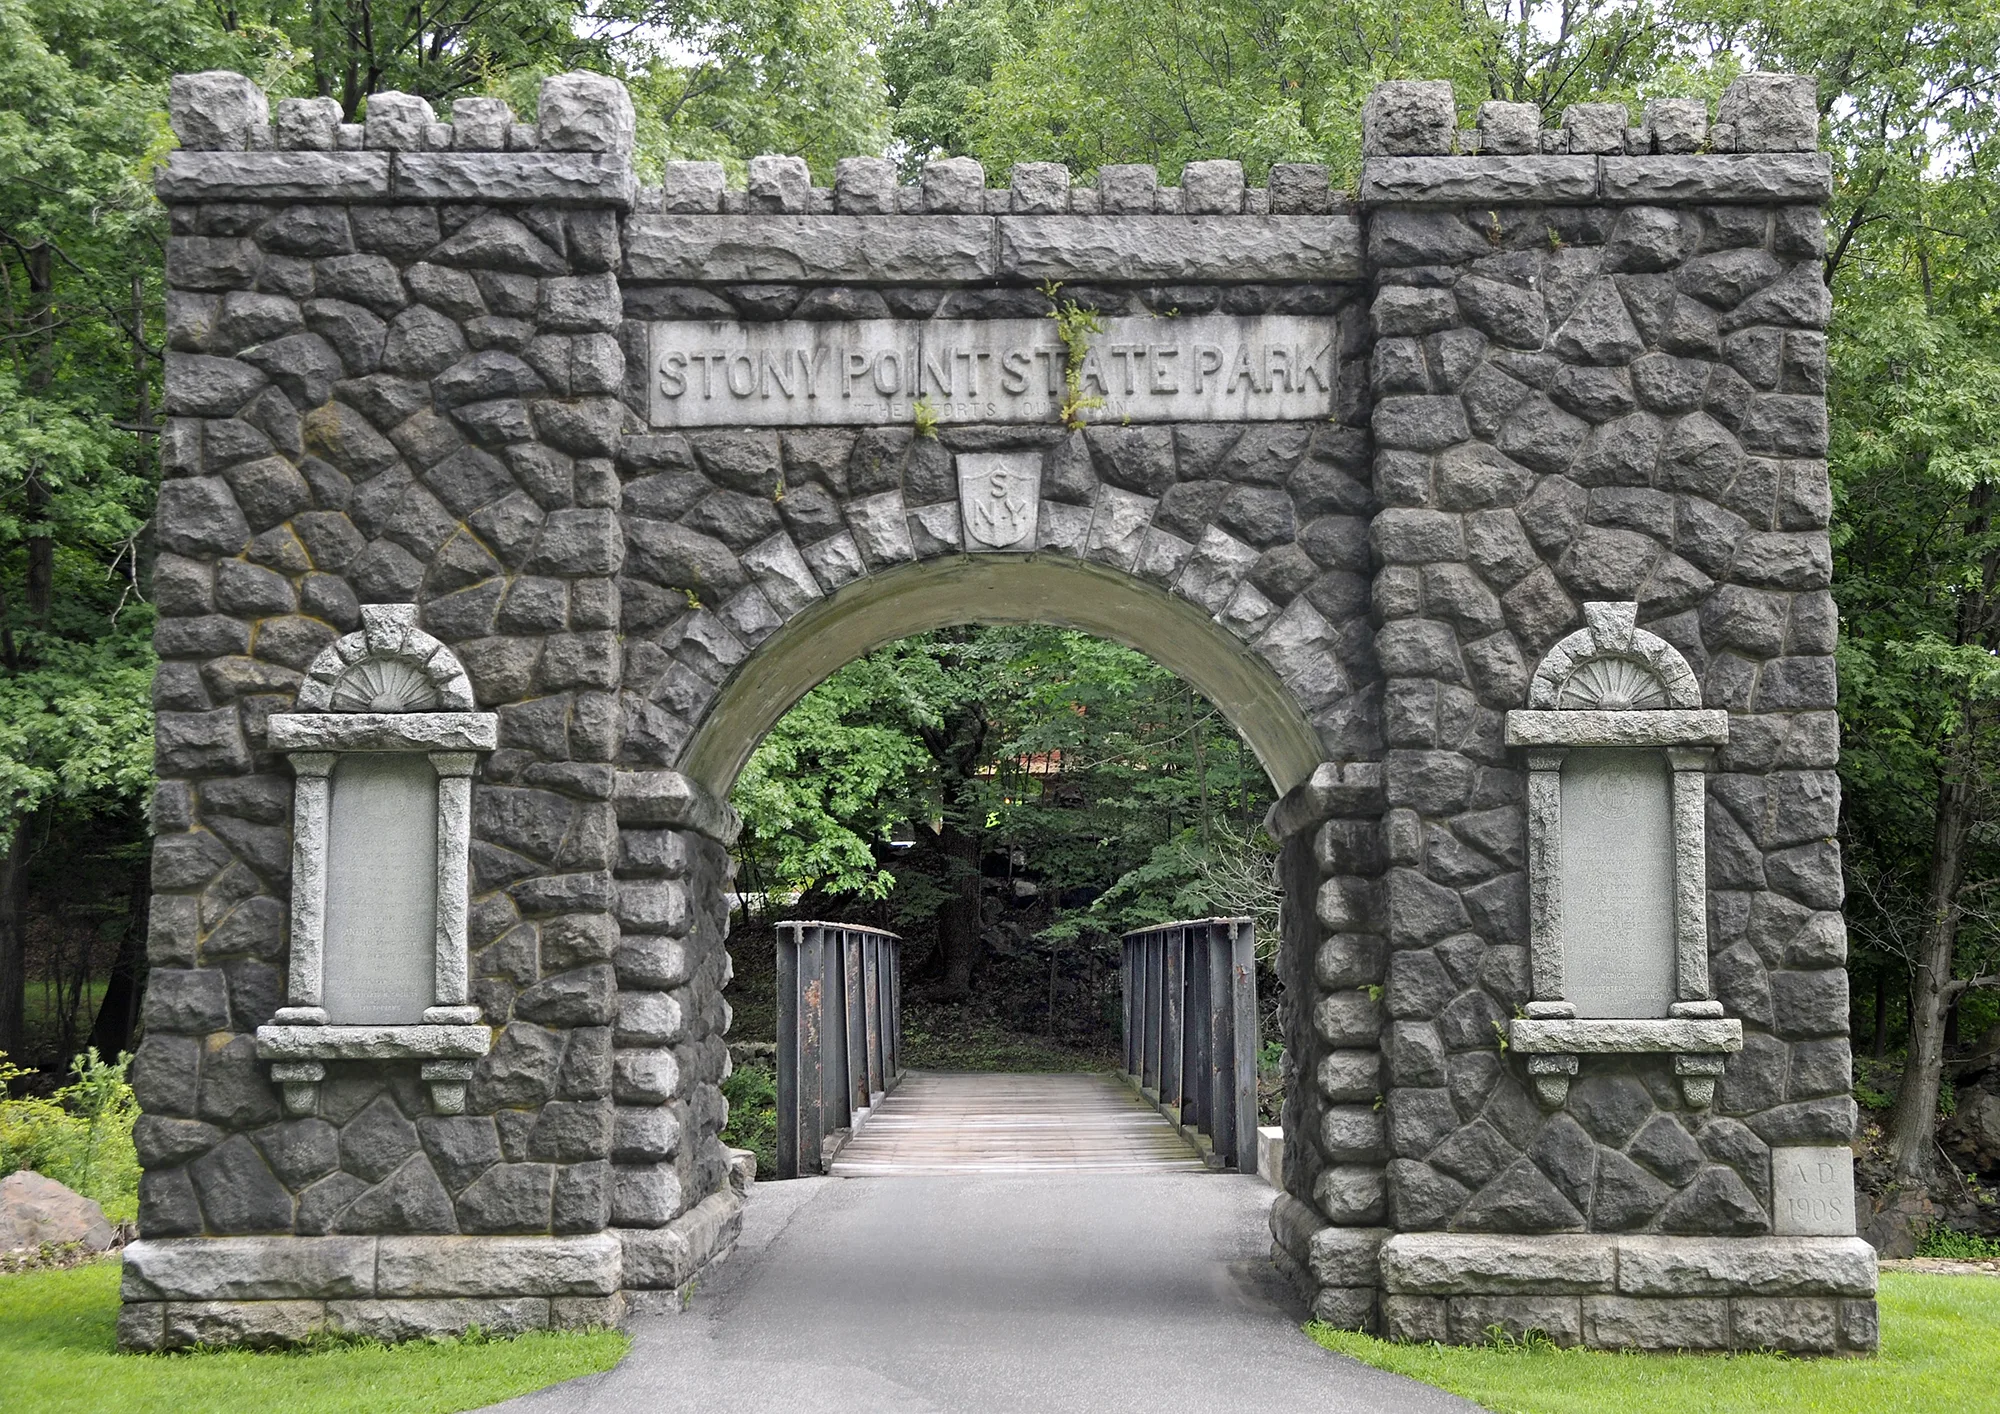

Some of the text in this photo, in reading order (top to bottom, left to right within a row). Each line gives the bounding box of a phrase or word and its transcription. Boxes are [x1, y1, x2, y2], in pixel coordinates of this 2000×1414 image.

[660, 342, 1336, 399] STONY POINT STATE PARK
[990, 470, 1007, 498] S
[1788, 1197, 1842, 1221] 1908
